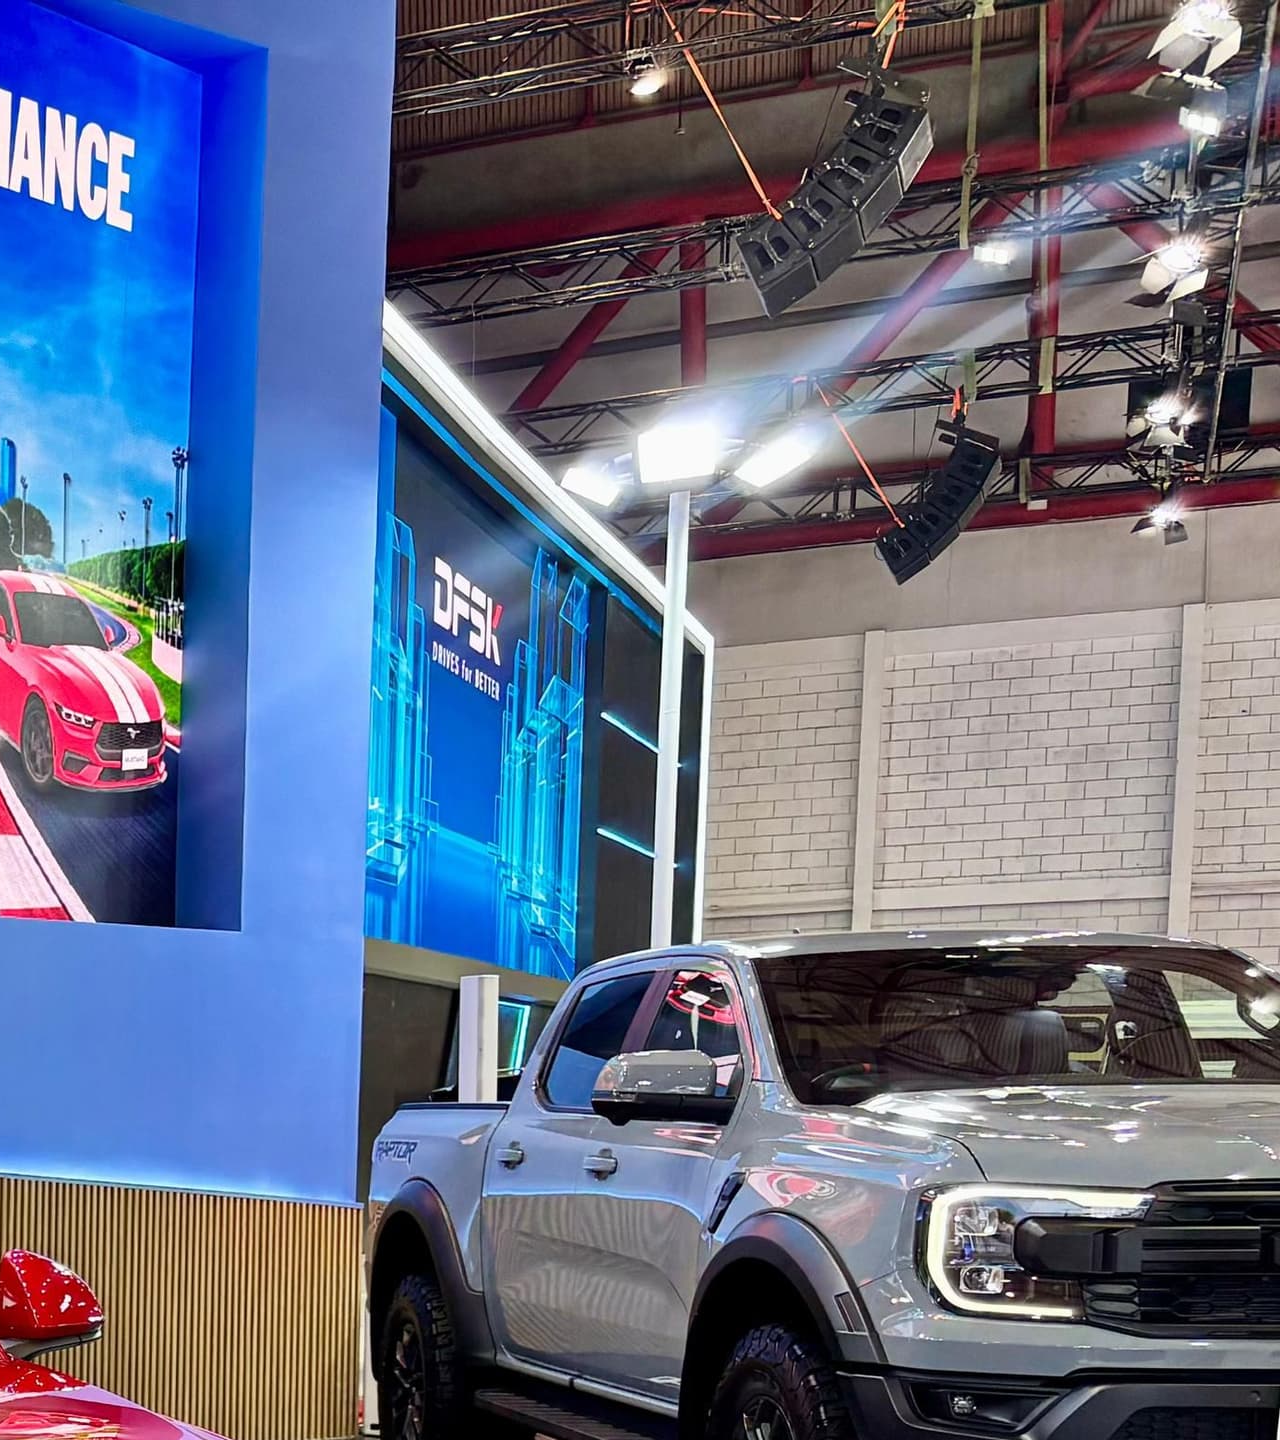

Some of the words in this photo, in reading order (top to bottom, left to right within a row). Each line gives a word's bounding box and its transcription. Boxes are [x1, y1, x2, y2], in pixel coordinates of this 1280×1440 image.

[434, 556, 503, 666] DFSK
[474, 668, 500, 700] BETTER
[375, 1141, 419, 1165] RAPTOR
